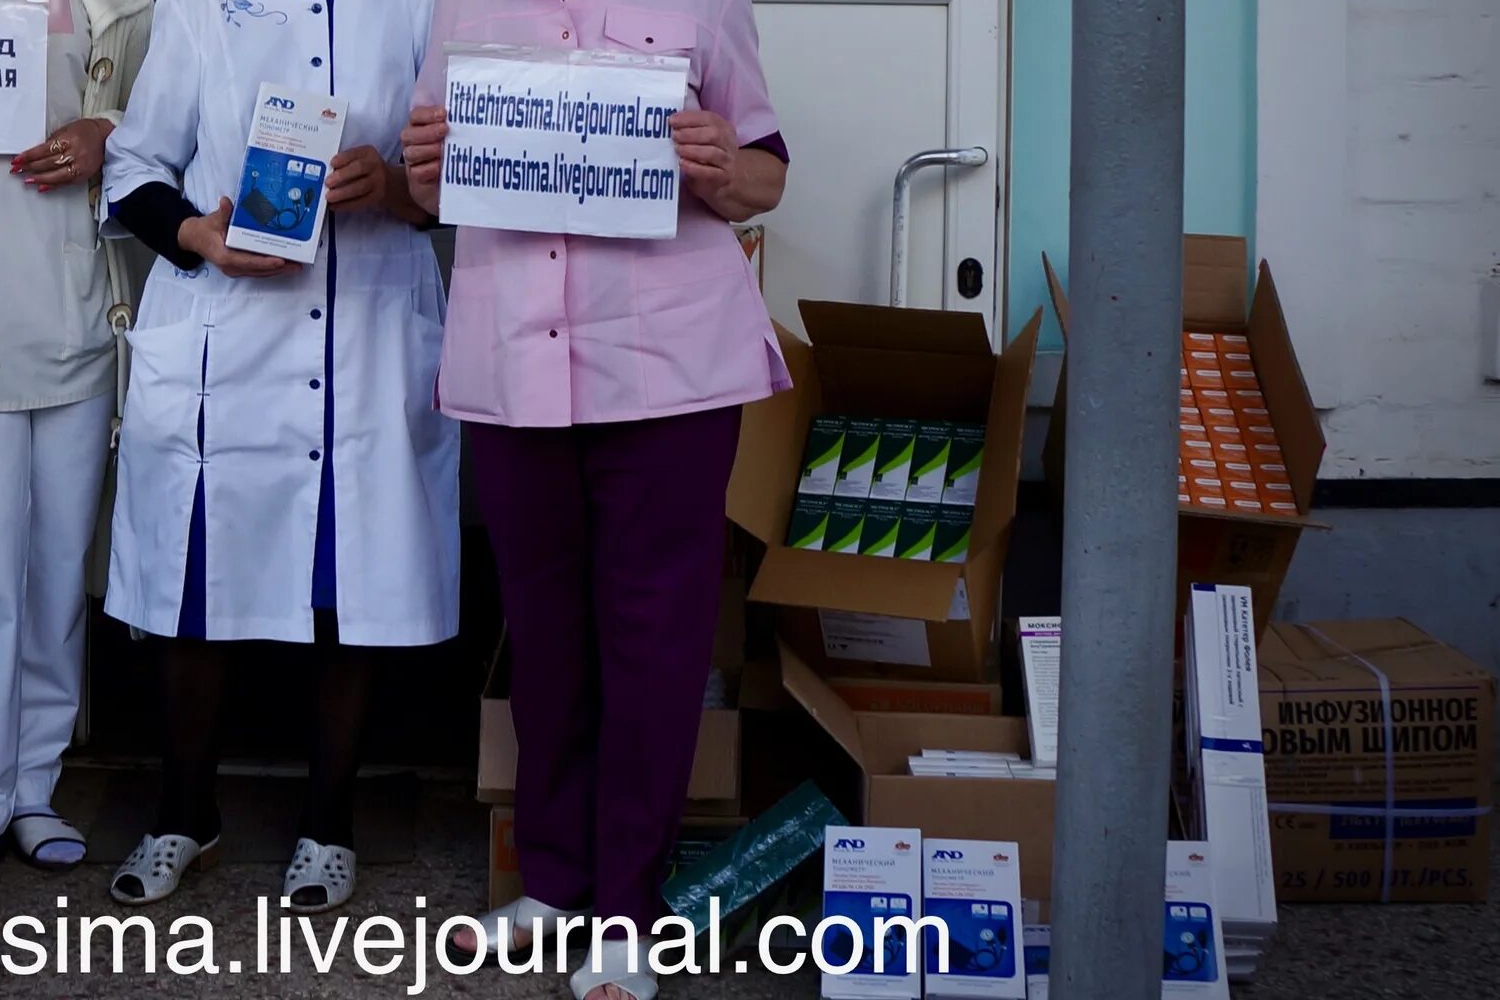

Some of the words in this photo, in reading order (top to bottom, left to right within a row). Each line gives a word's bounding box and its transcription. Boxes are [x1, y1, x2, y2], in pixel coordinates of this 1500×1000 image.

[448, 81, 678, 143] littlehirosima.livejournal.com
[445, 143, 674, 204] littlehirosima.livejournal.com
[1278, 698, 1478, 725] ИНФУЗИОННОЕ
[1262, 728, 1350, 755] ОВЫМ
[1362, 724, 1477, 753] ШИПОМ
[1282, 871, 1306, 889] 25
[1333, 871, 1371, 889] 500
